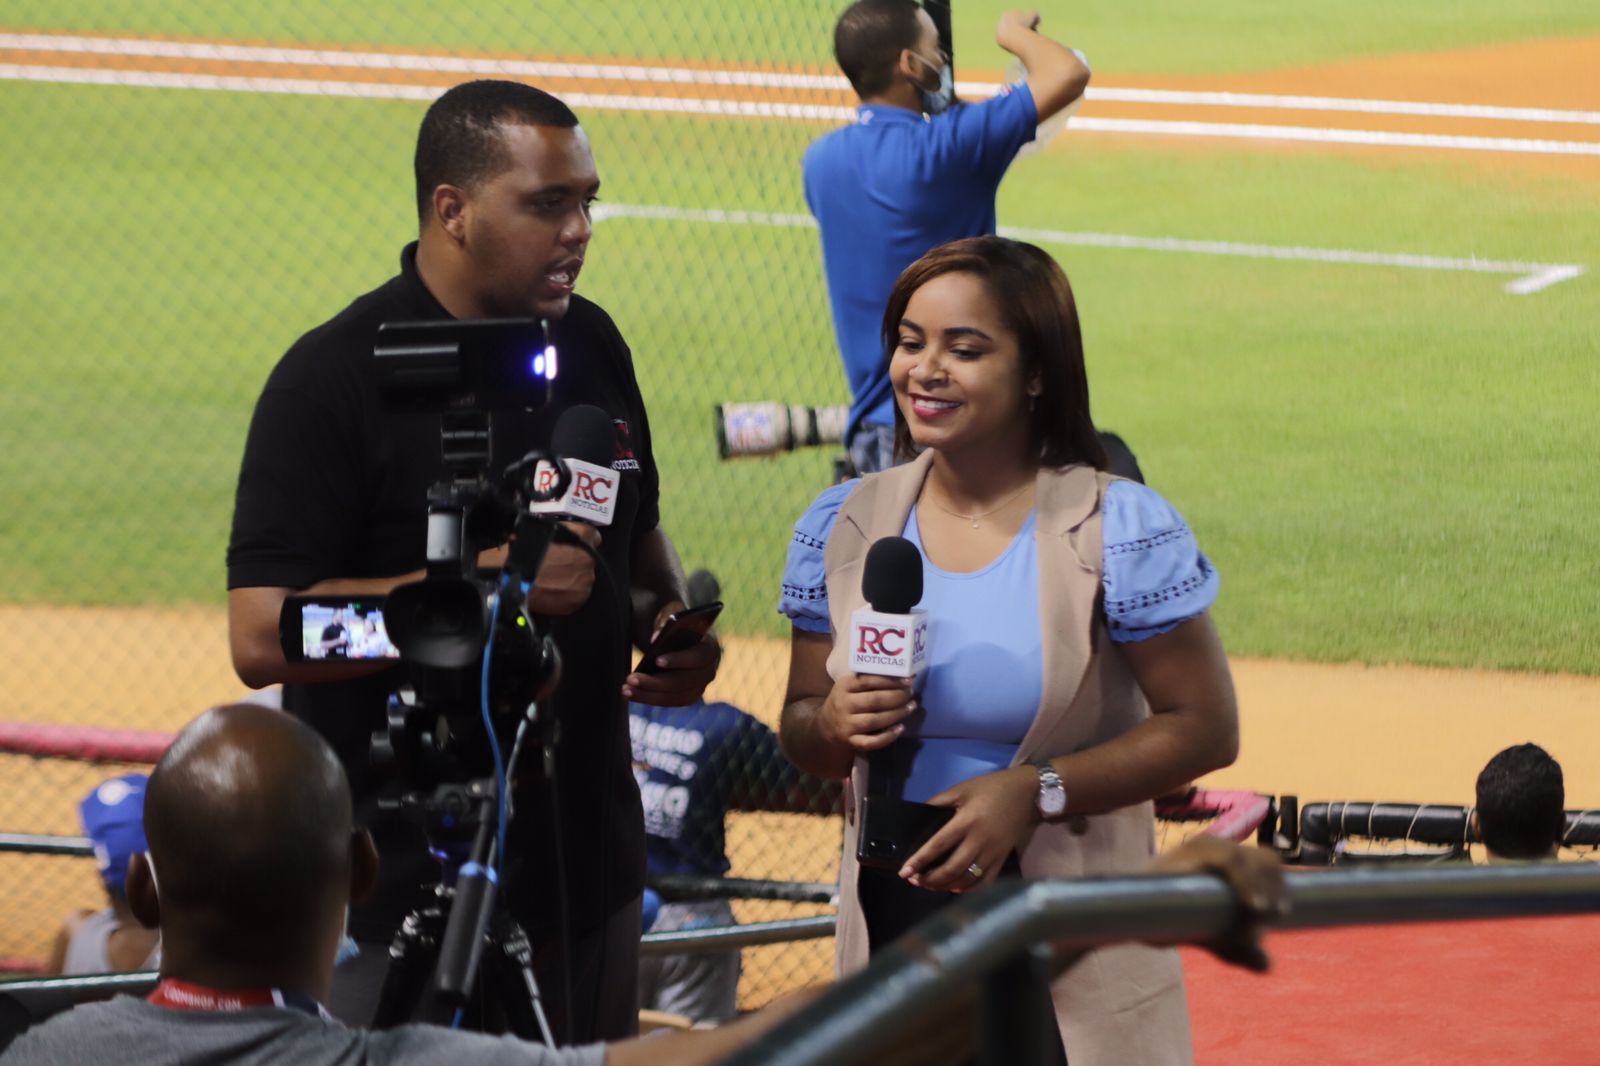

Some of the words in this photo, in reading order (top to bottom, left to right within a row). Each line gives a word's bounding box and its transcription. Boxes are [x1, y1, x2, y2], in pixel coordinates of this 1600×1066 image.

[573, 471, 613, 504] RC
[571, 499, 609, 514] NOTICIAS
[857, 625, 905, 656] RC
[856, 654, 904, 666] NOTICIAS
